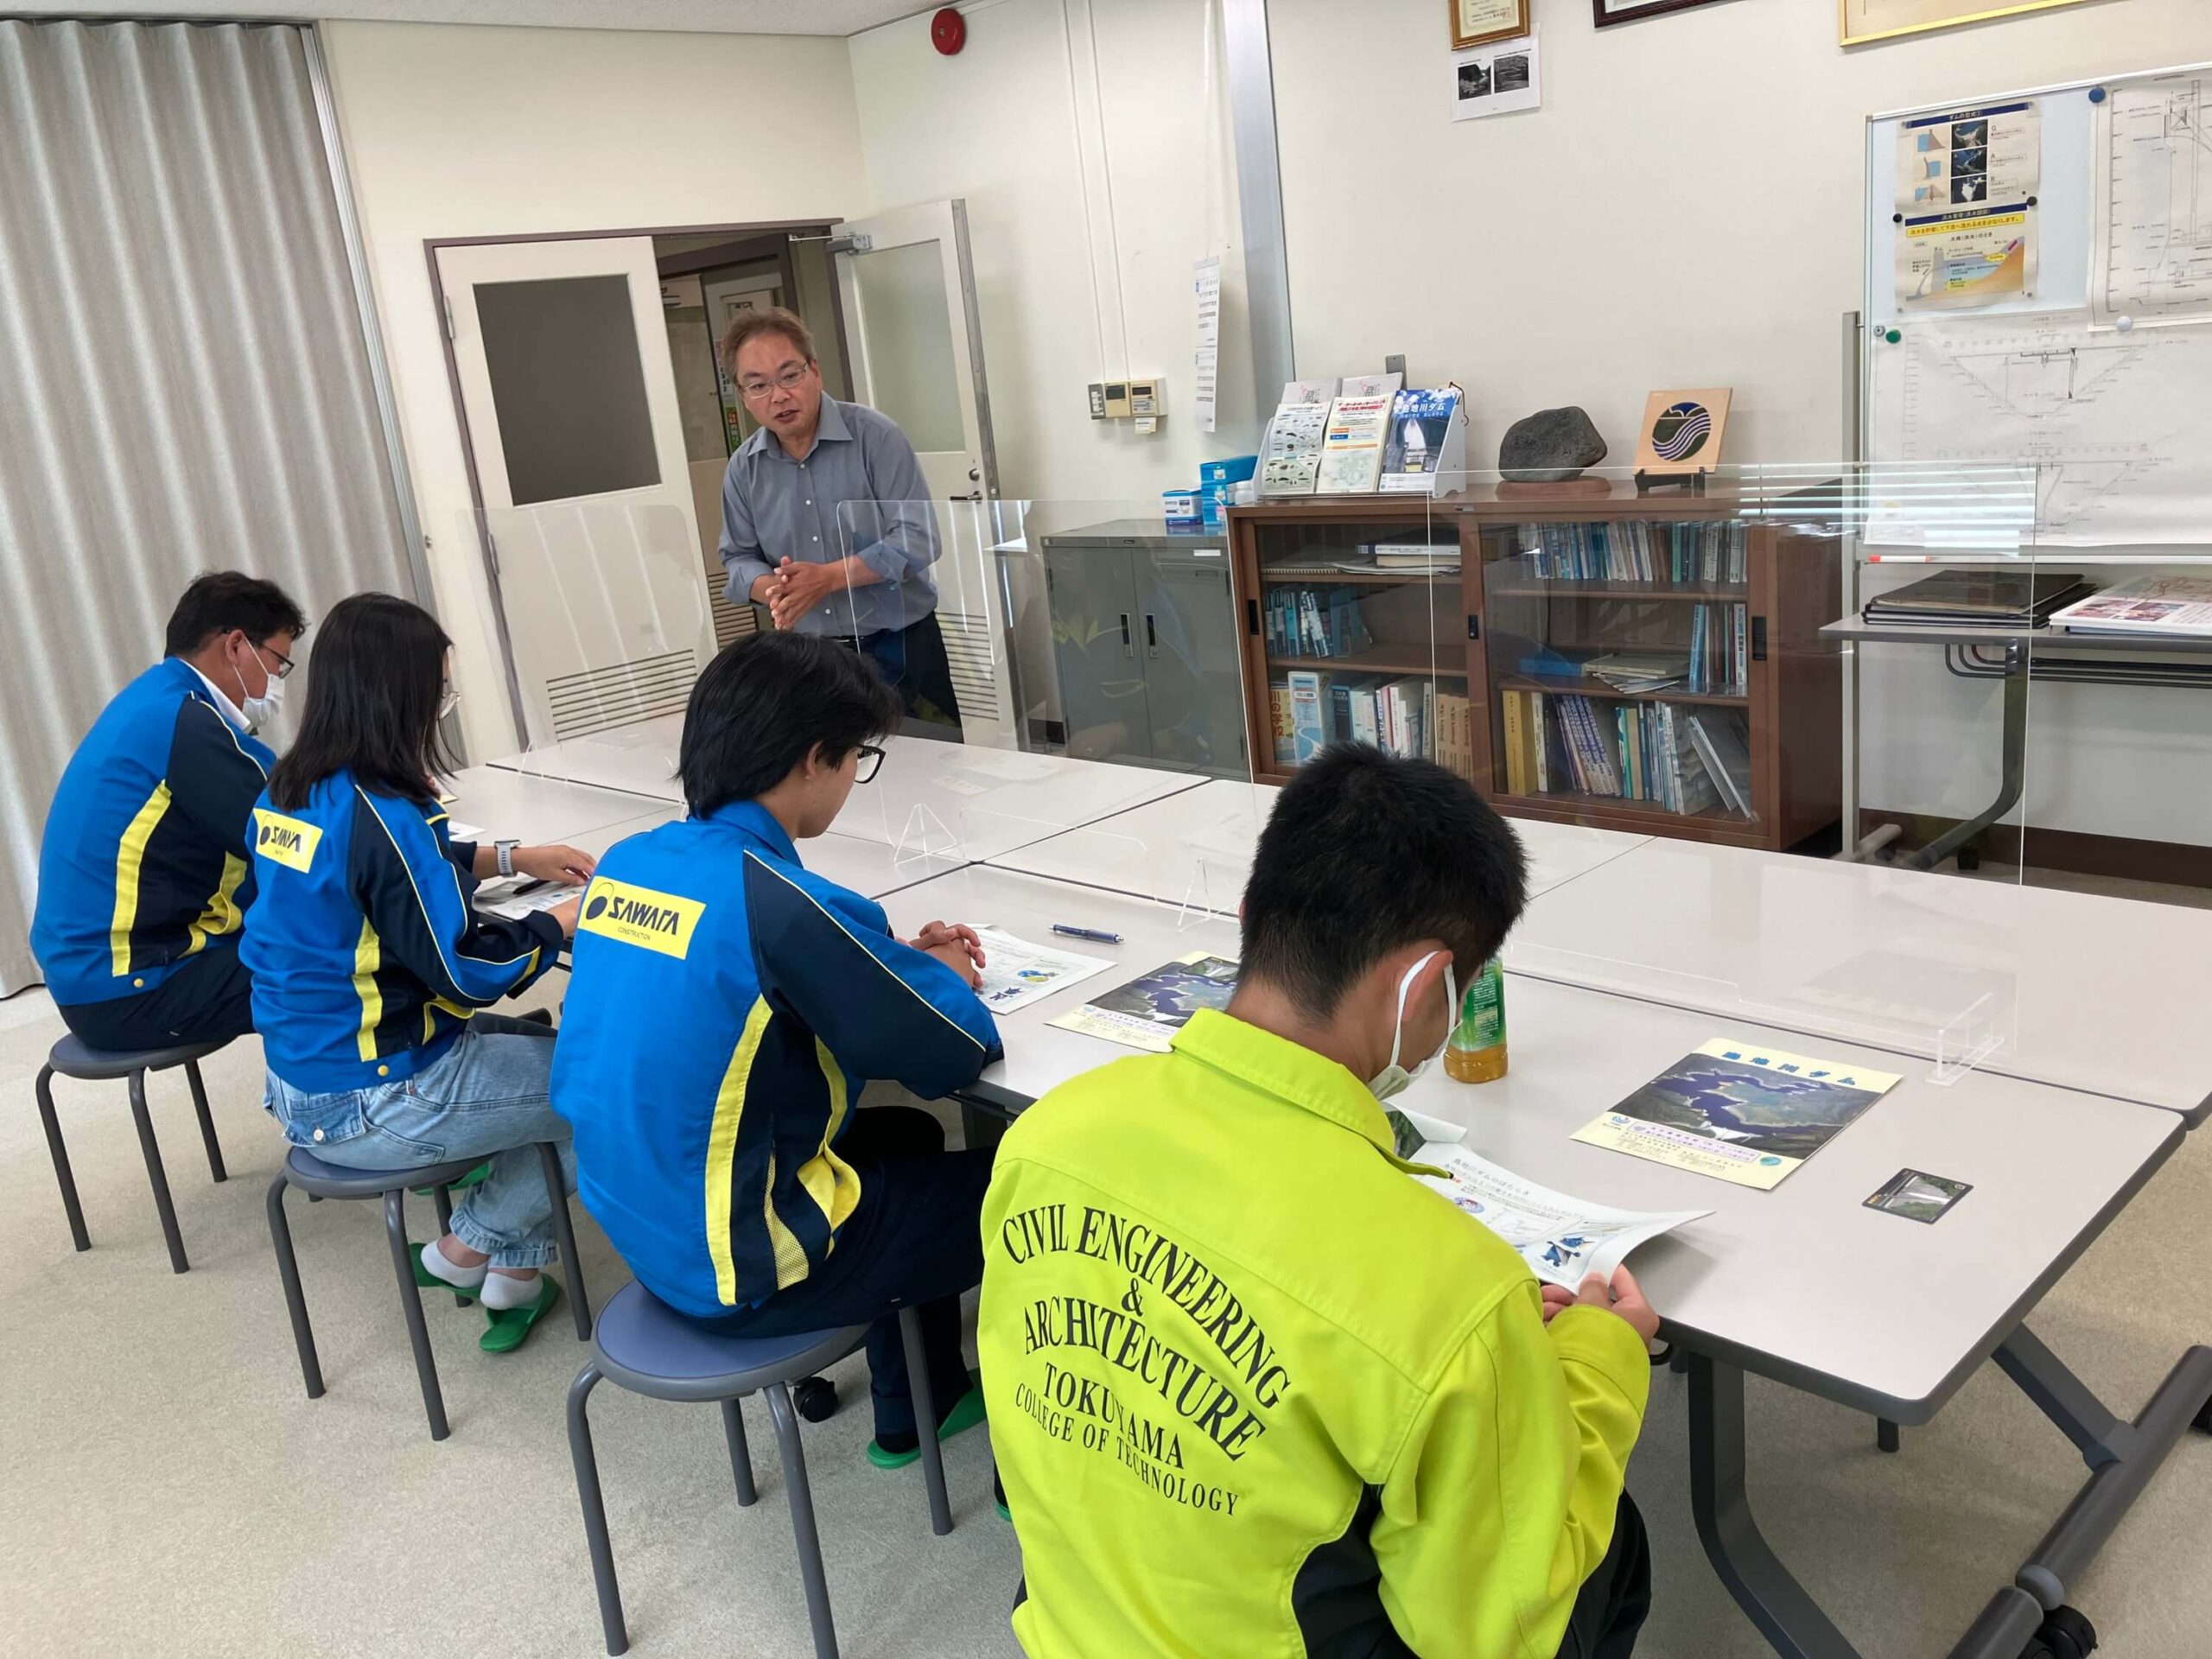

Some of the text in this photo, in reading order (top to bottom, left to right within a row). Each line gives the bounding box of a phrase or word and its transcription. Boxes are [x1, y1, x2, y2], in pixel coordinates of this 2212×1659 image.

[607, 896, 680, 936] SAWATA
[617, 926, 652, 941] CONSTRUCTION
[1002, 1204, 1292, 1409] CIVIL ENGINEERING
[1121, 1278, 1144, 1317] &
[1025, 1296, 1267, 1462] ARCHITECTURE
[1044, 1362, 1184, 1470] TOKUYAMA
[1015, 1382, 1239, 1516] COLLEGE OF TECHNOLOGY
